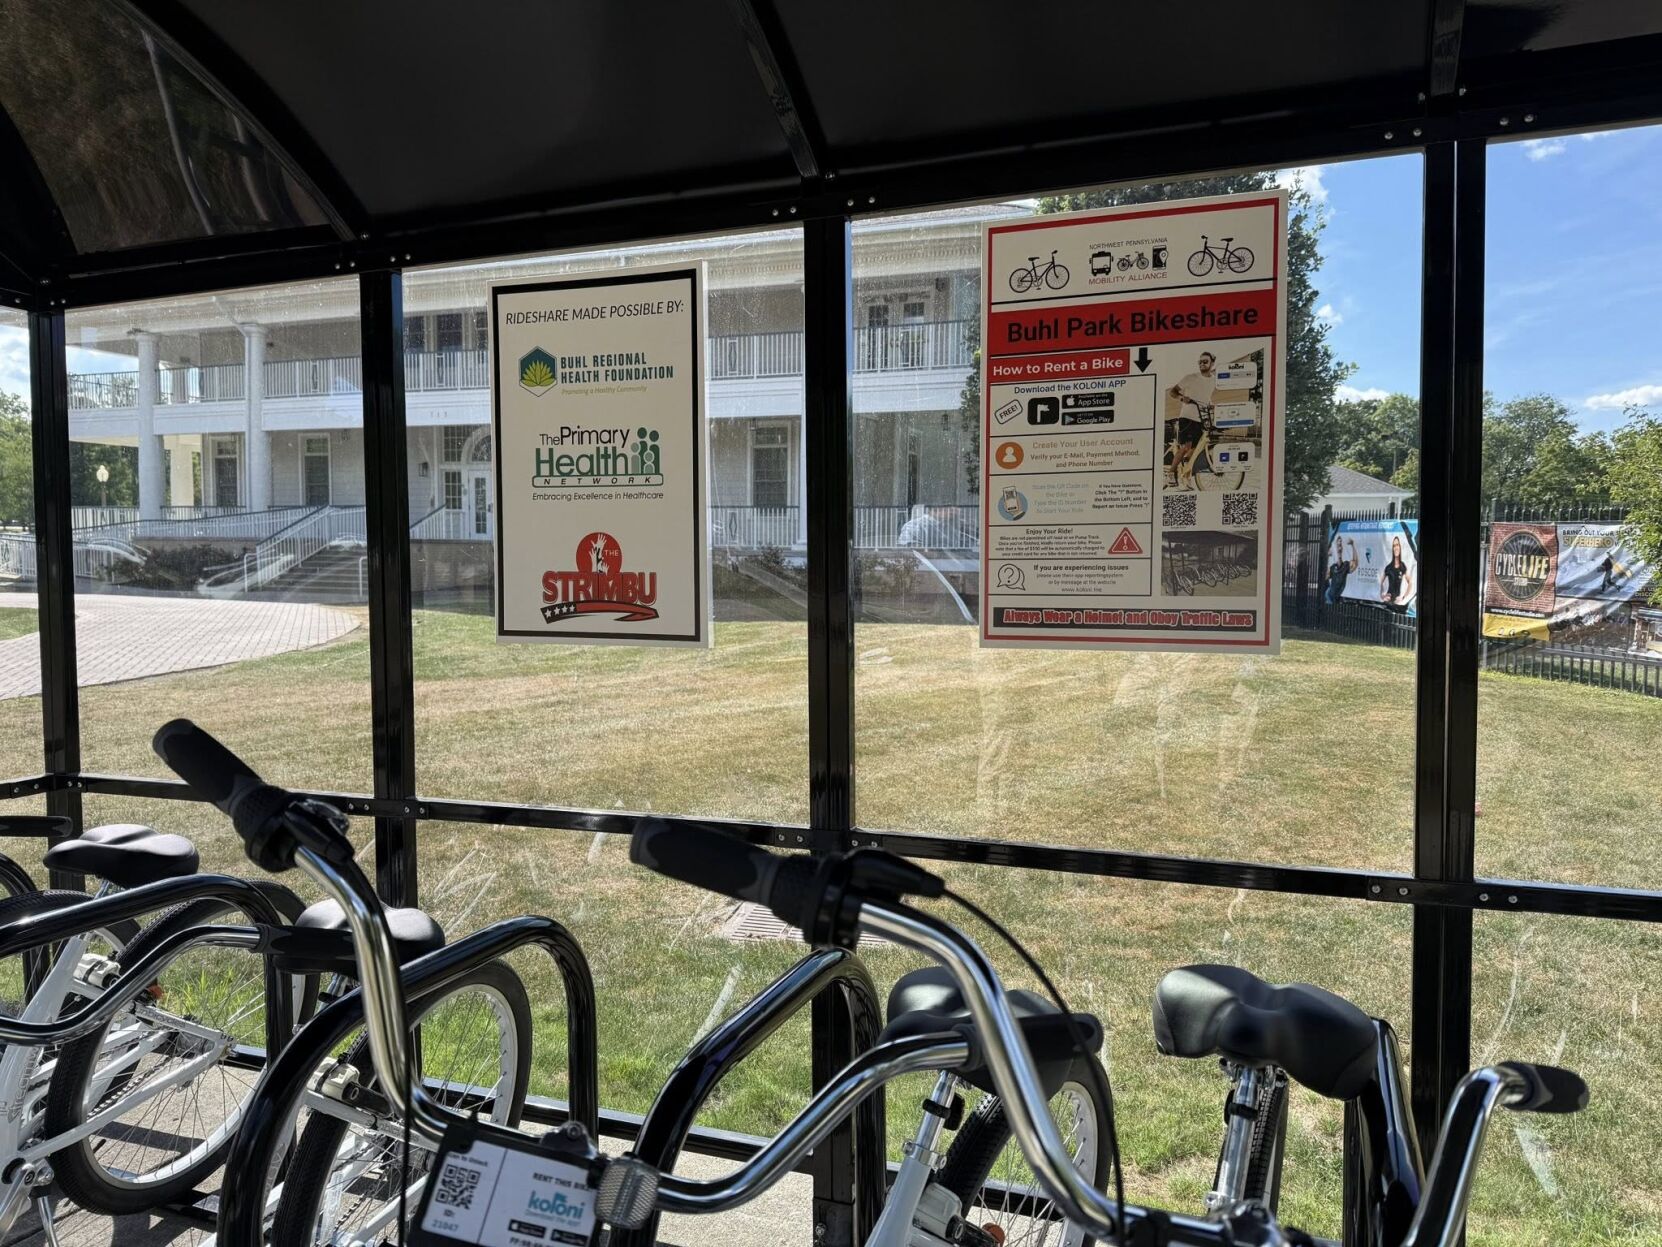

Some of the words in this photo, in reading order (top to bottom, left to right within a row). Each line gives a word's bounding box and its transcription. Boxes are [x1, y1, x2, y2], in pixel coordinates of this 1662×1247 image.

[1089, 241, 1124, 250] NORTHWEST
[1126, 237, 1168, 247] PENNSYLVANIA
[1088, 275, 1126, 286] MOBILITY
[1128, 272, 1168, 282] ALLIANCE
[506, 308, 569, 325] RIDESHARE
[572, 306, 606, 321] MADE
[610, 302, 664, 318] POSSIBLE
[666, 300, 684, 314] BY:
[1007, 319, 1059, 343] Buhl
[1066, 312, 1122, 338] Park
[1130, 306, 1260, 334] Bikeshare
[560, 356, 588, 369] BUHL
[592, 352, 647, 367] REGIONAL
[992, 364, 1024, 376] How
[1026, 362, 1041, 374] to
[1044, 360, 1078, 374] Rent
[1080, 362, 1088, 370] a
[1092, 357, 1124, 370] Bike
[560, 369, 600, 384] HEALTH
[604, 366, 674, 382] FOUNDATION
[1014, 384, 1056, 394] Download
[1058, 383, 1072, 392] the
[1072, 382, 1107, 391] KOLONI
[1108, 380, 1127, 388] APP
[1078, 398, 1092, 406] App
[1092, 398, 1111, 406] Store
[998, 404, 1019, 420] FREE!
[539, 433, 560, 446] The
[560, 426, 630, 448] Primary
[1032, 440, 1058, 450] Create
[1060, 440, 1078, 448] Your
[1080, 439, 1098, 448] User
[1100, 438, 1134, 446] Account
[535, 446, 629, 477] Health
[1030, 453, 1048, 461] Verify
[543, 476, 652, 486] NETWORK
[532, 492, 572, 502] Embracing
[574, 492, 613, 500] Excellence
[614, 492, 622, 500] in
[622, 492, 664, 500] Healthcare
[1563, 536, 1614, 548] SUPERHERO
[604, 549, 619, 557] THE
[542, 570, 658, 606] STRIMBU
[1003, 609, 1042, 625] Always
[1042, 610, 1074, 625] Wear
[1074, 611, 1082, 624] a
[1083, 610, 1124, 625] Helmet
[1125, 610, 1148, 626] and
[1150, 610, 1180, 627] Obey
[1180, 611, 1220, 626] Traffic
[1222, 612, 1254, 627] Laws
[532, 1172, 553, 1185] RENT
[554, 1178, 572, 1188] THIS
[444, 1208, 455, 1218] ID:
[528, 1191, 586, 1219] koloni
